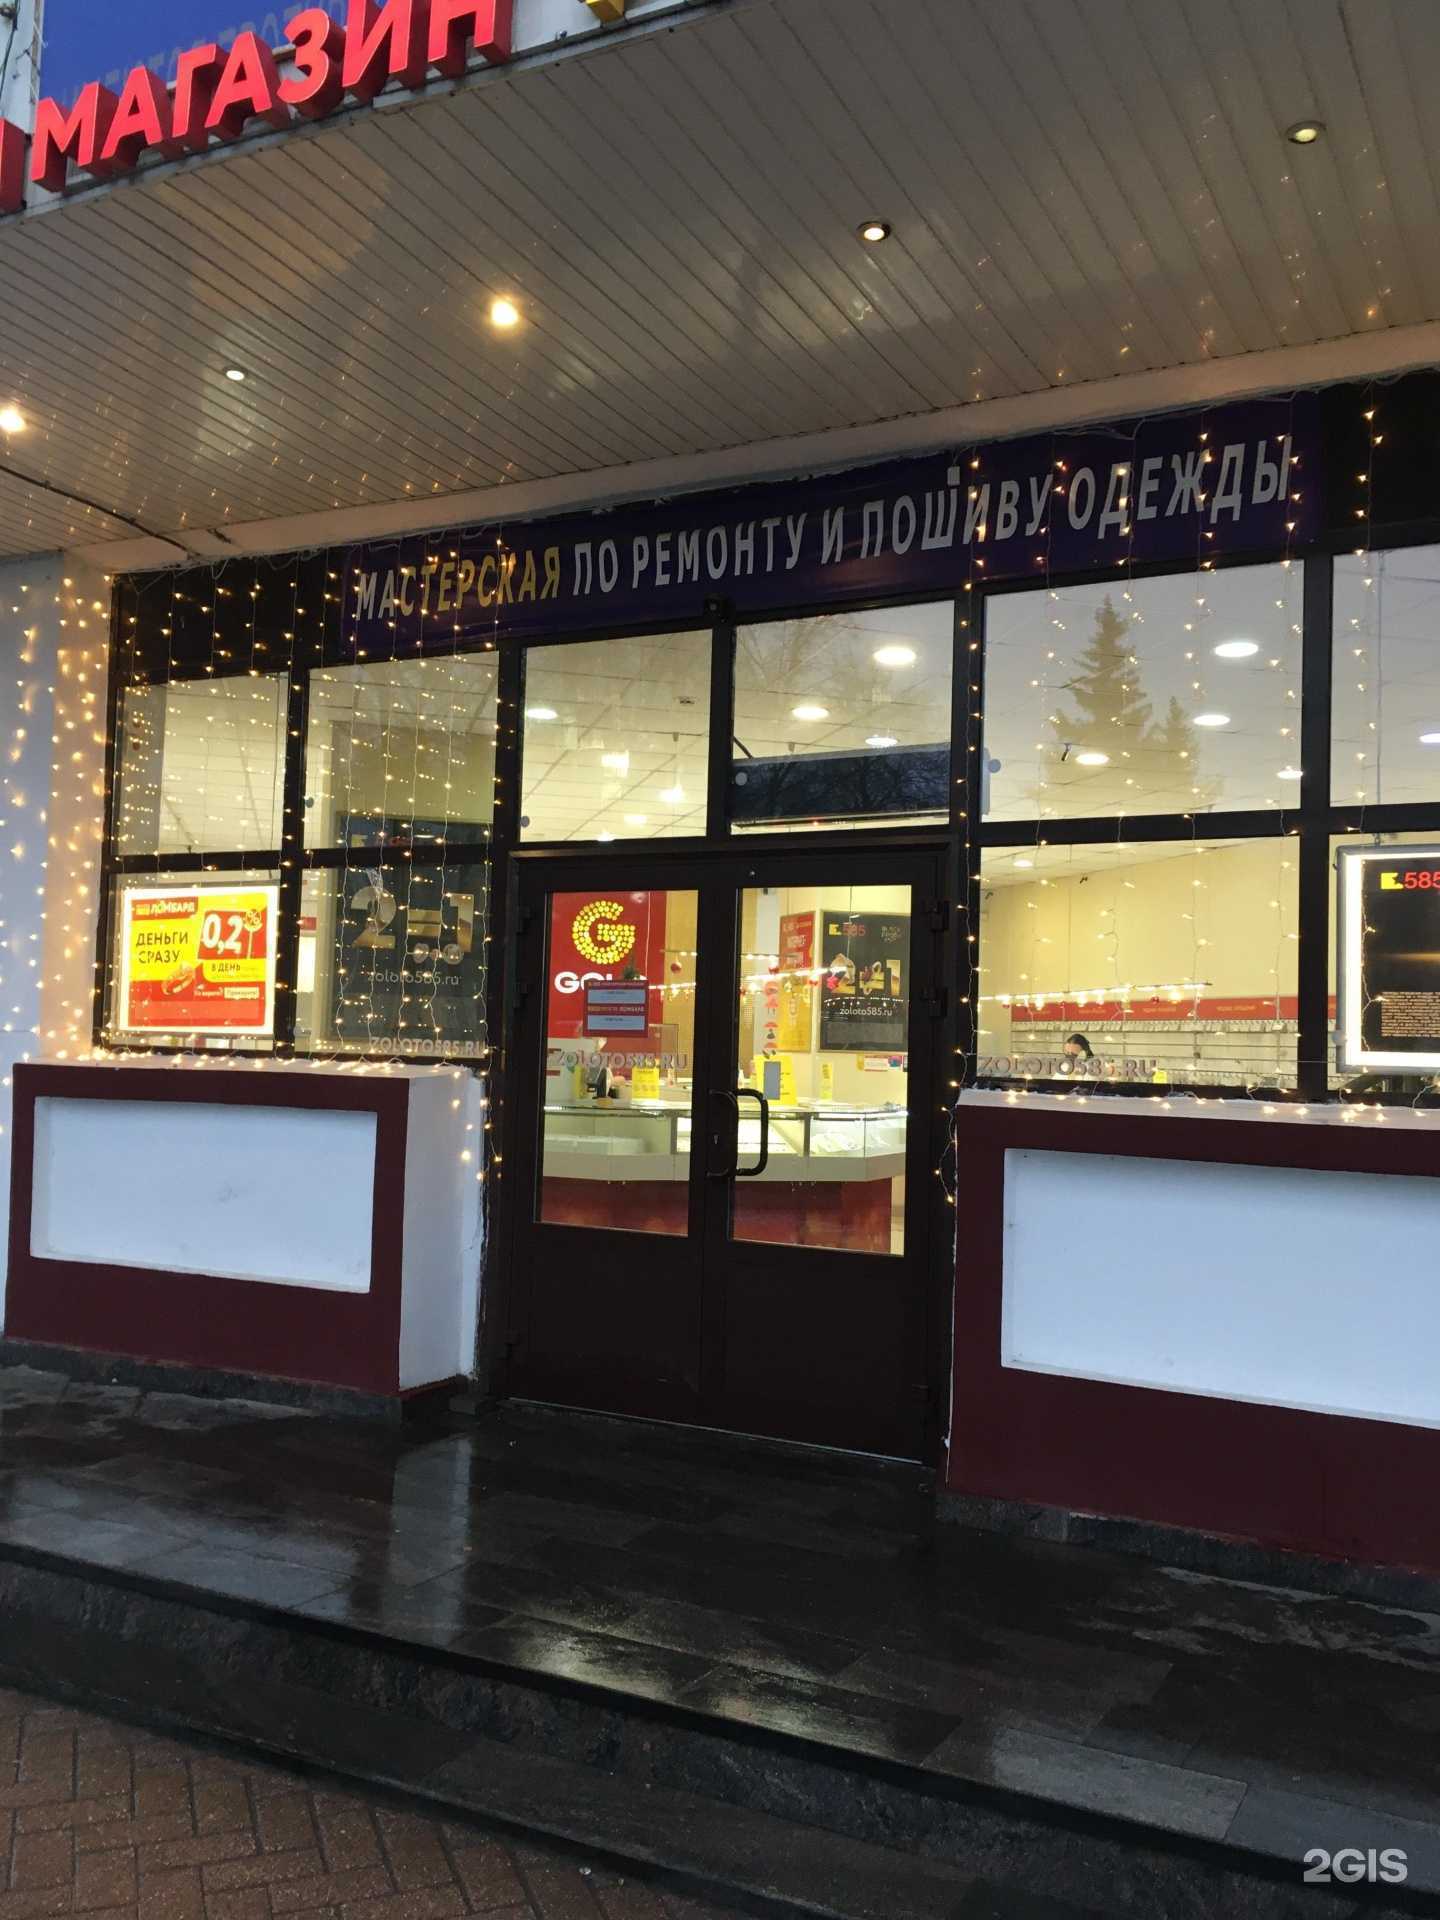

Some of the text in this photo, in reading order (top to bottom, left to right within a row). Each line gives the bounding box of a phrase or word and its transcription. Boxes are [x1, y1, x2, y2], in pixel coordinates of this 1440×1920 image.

[31, 0, 500, 185] МАГАЗИН
[355, 435, 1294, 621] МАСТЕРСКАЯ ПО РЕМОНТУ И ПОШИВУ ОДЕЖДЫ
[136, 932, 189, 947] ДЕНЬГИ
[138, 950, 181, 964] СРАЗУ
[218, 963, 241, 973] ДЕНЬ
[839, 1006, 893, 1017] zoloto585.ru
